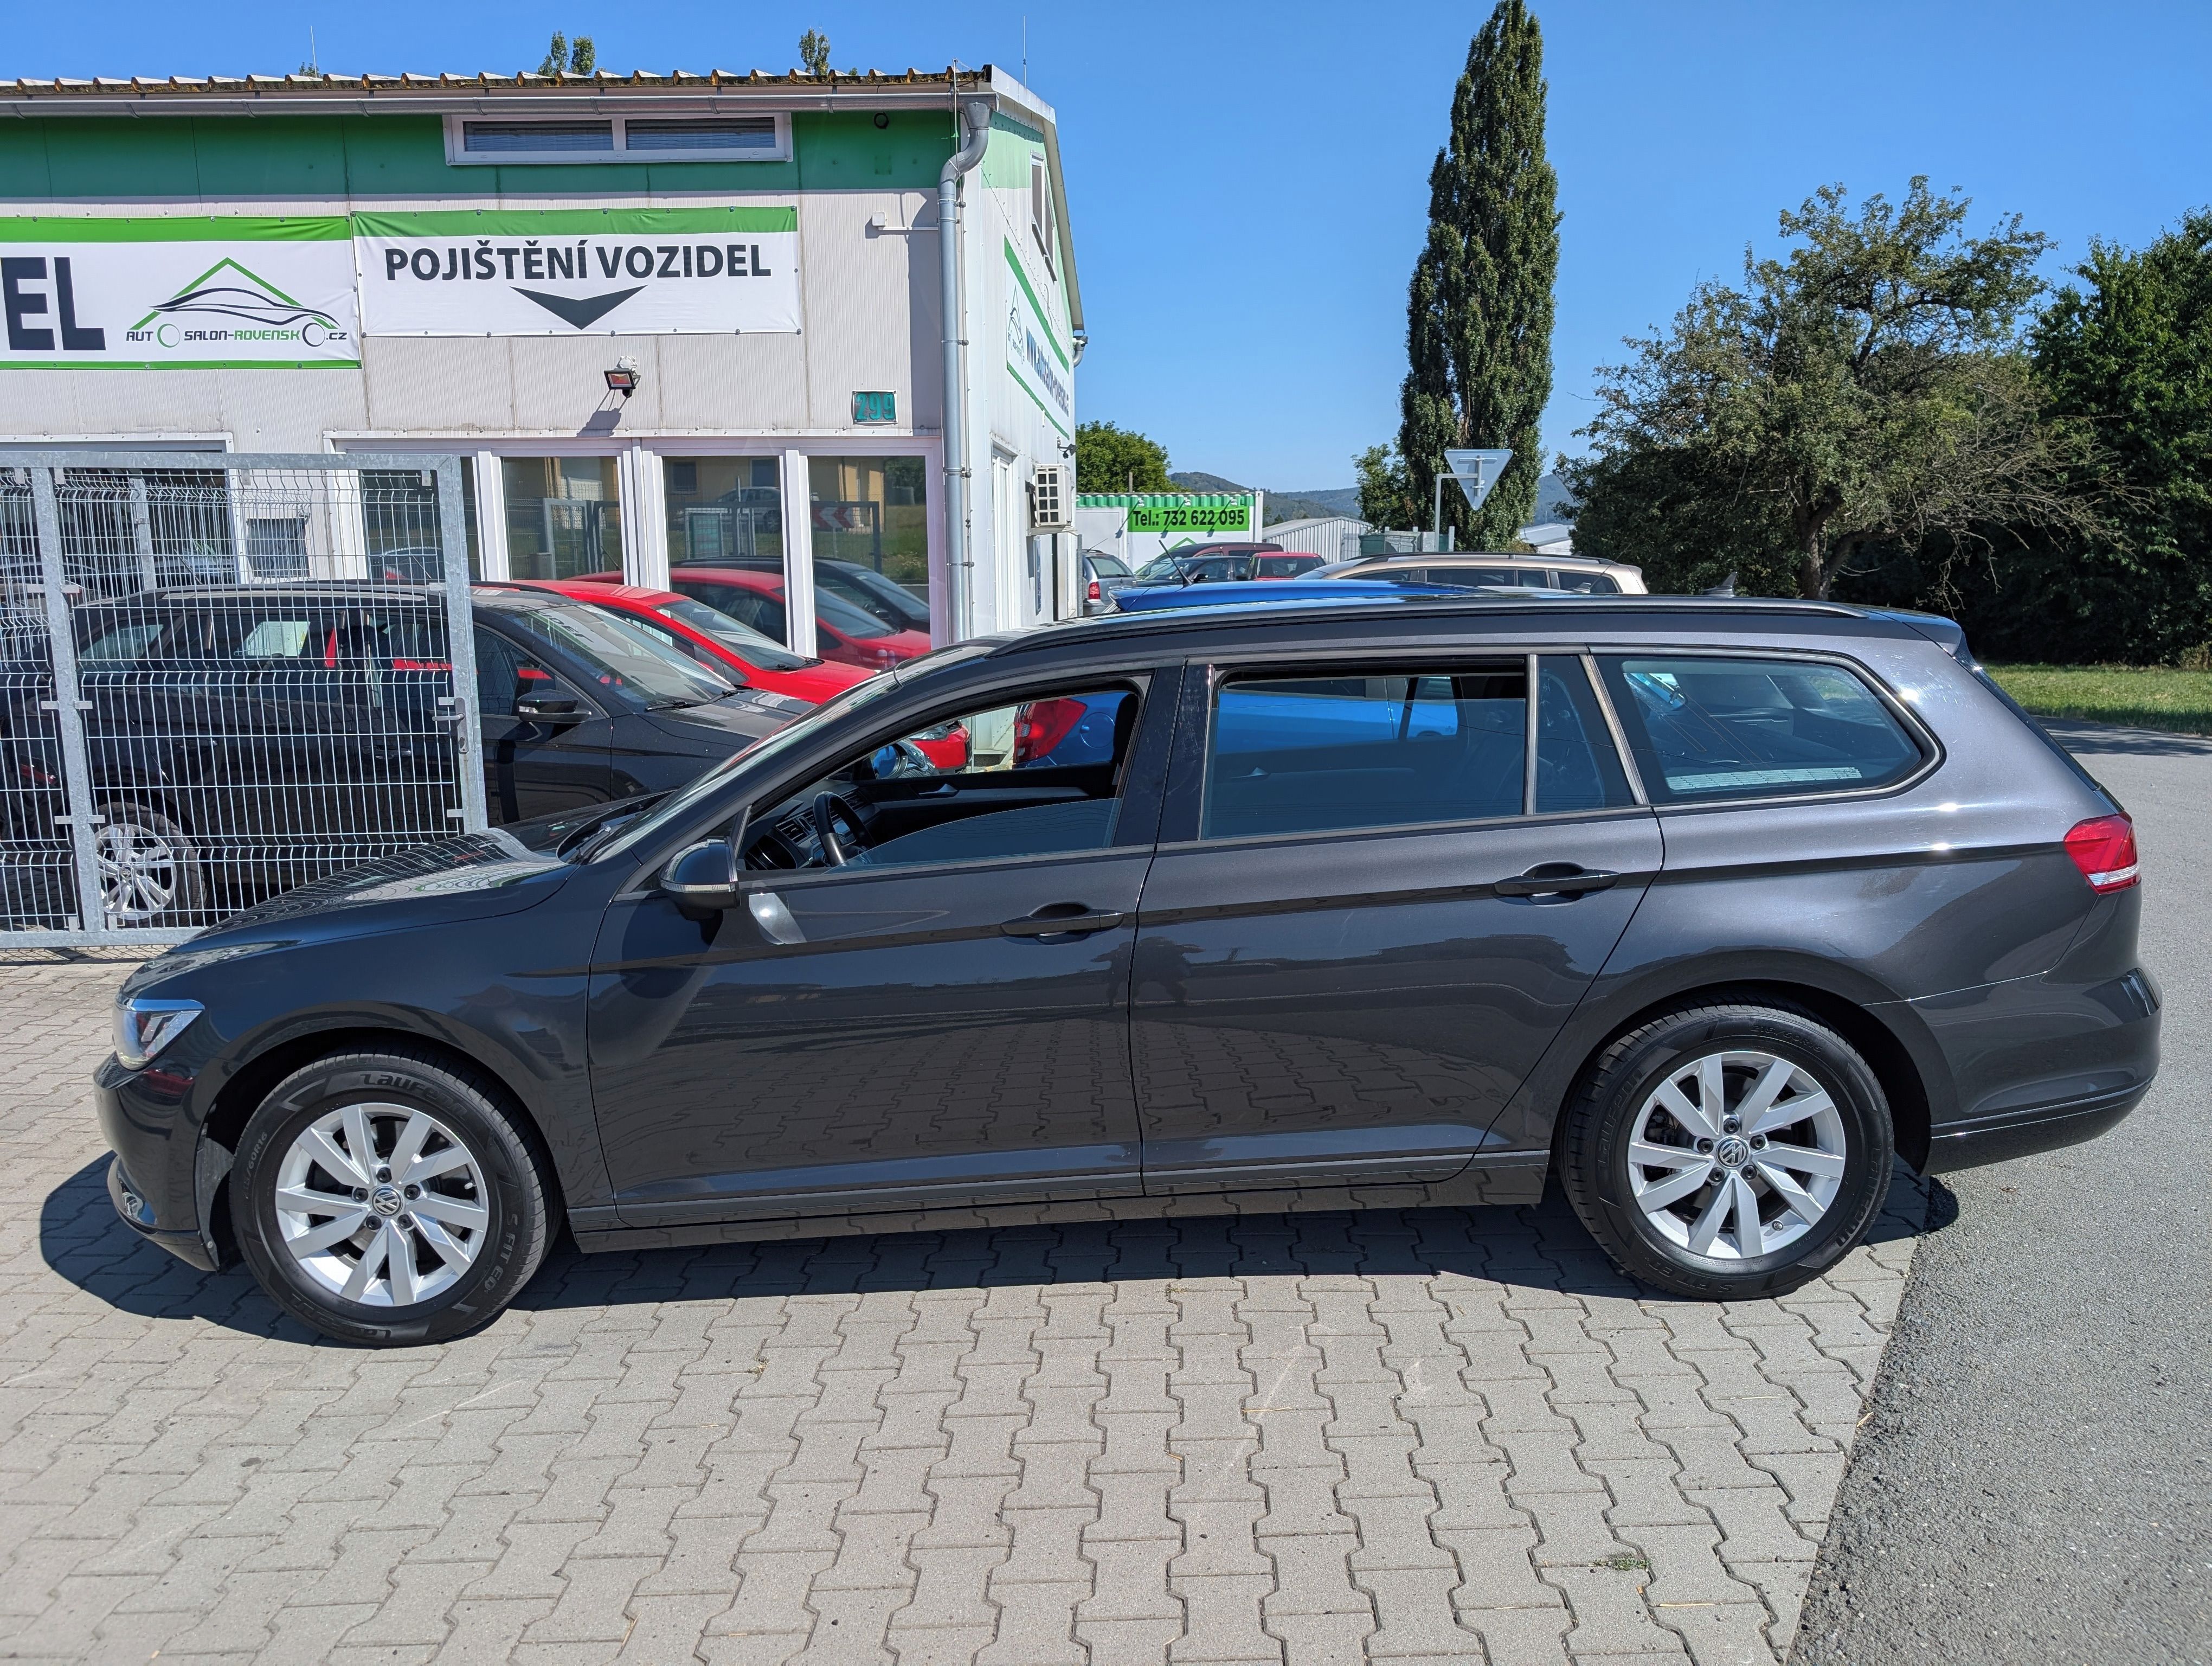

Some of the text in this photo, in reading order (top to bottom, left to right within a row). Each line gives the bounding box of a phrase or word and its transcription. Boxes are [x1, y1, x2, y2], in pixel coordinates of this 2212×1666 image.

[384, 239, 771, 281] POJIŠTĚNÍ VOZIDEL
[856, 393, 895, 420] 299
[1133, 509, 1244, 526] Tel.: 732 622 095
